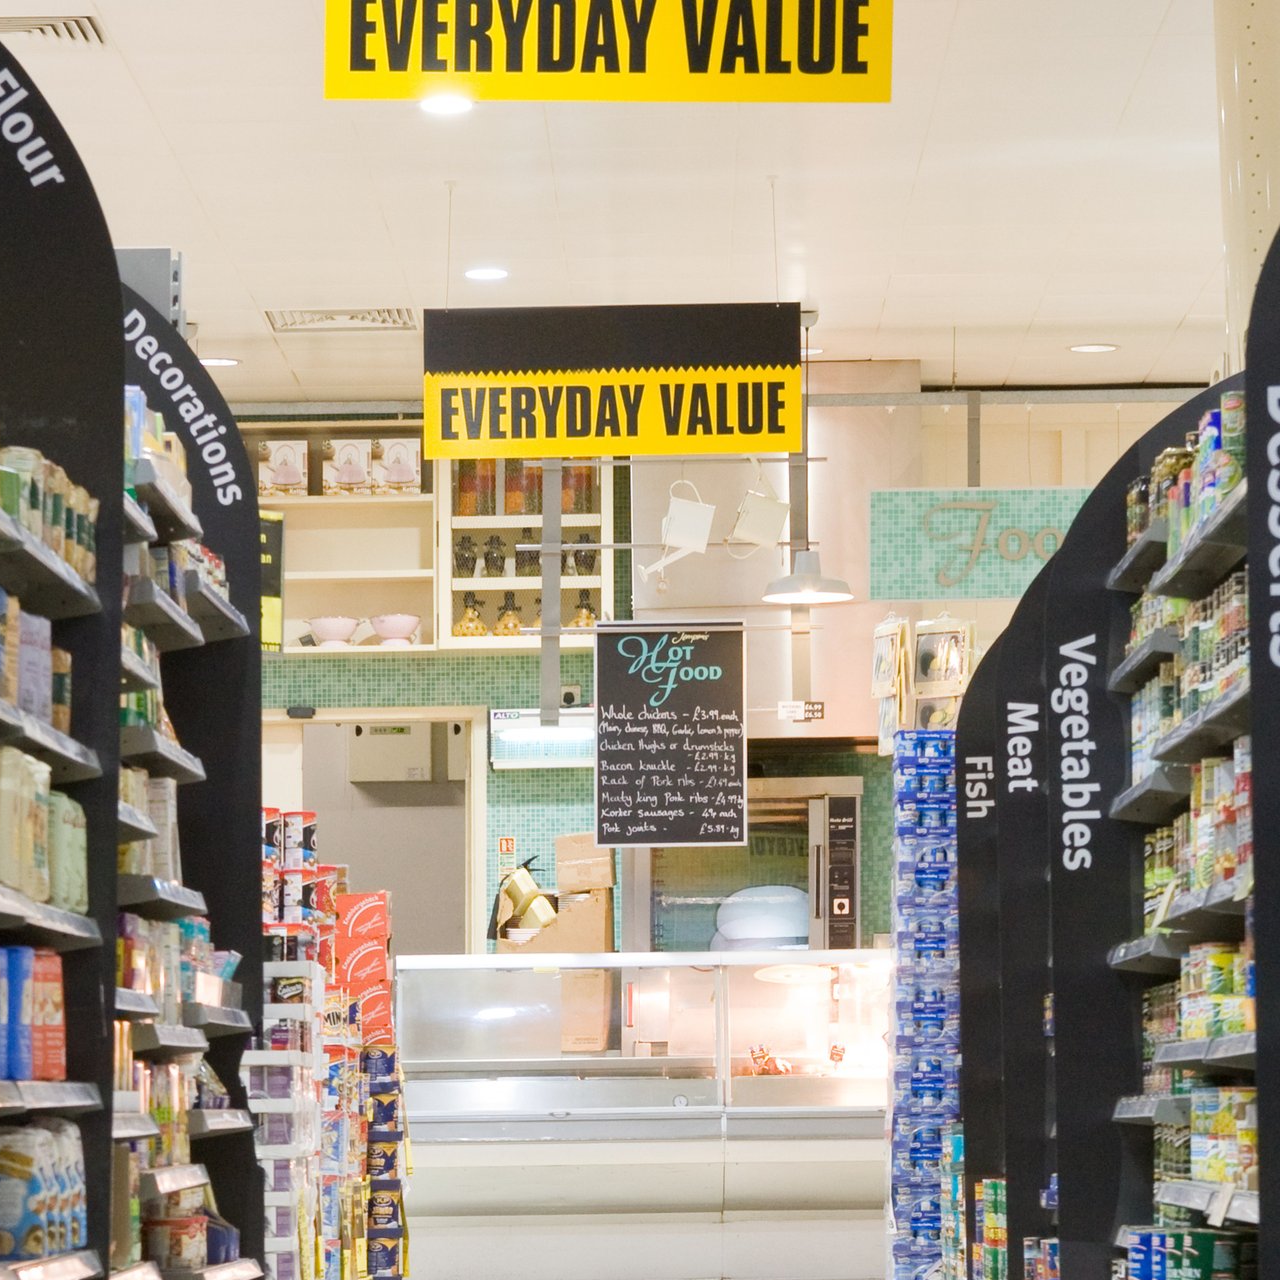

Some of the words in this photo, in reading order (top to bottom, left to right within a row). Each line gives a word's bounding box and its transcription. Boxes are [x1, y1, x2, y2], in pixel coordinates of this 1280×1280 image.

[349, 0, 657, 74] EVERYDAY
[680, 0, 870, 74] VALUE
[123, 308, 242, 508] Decorations
[441, 383, 645, 441] EVERYDAY
[661, 381, 787, 437] VALUE
[601, 704, 634, 720] Whole
[669, 742, 678, 751] or
[682, 737, 735, 752] drumsticks
[1006, 701, 1040, 793] Meat
[1049, 633, 1102, 872] Vegetables
[600, 760, 635, 772] Bacon
[638, 759, 676, 772] knuckle
[601, 775, 629, 786] Rack
[635, 775, 646, 790] of
[650, 775, 674, 787] Pork
[677, 773, 696, 787] ribs
[964, 755, 997, 819] Fish
[601, 791, 633, 808] Meaty
[635, 790, 658, 808] king
[664, 791, 685, 807] Pork
[689, 791, 709, 804] ribs
[637, 808, 685, 821] sausages
[602, 822, 621, 836] Pork
